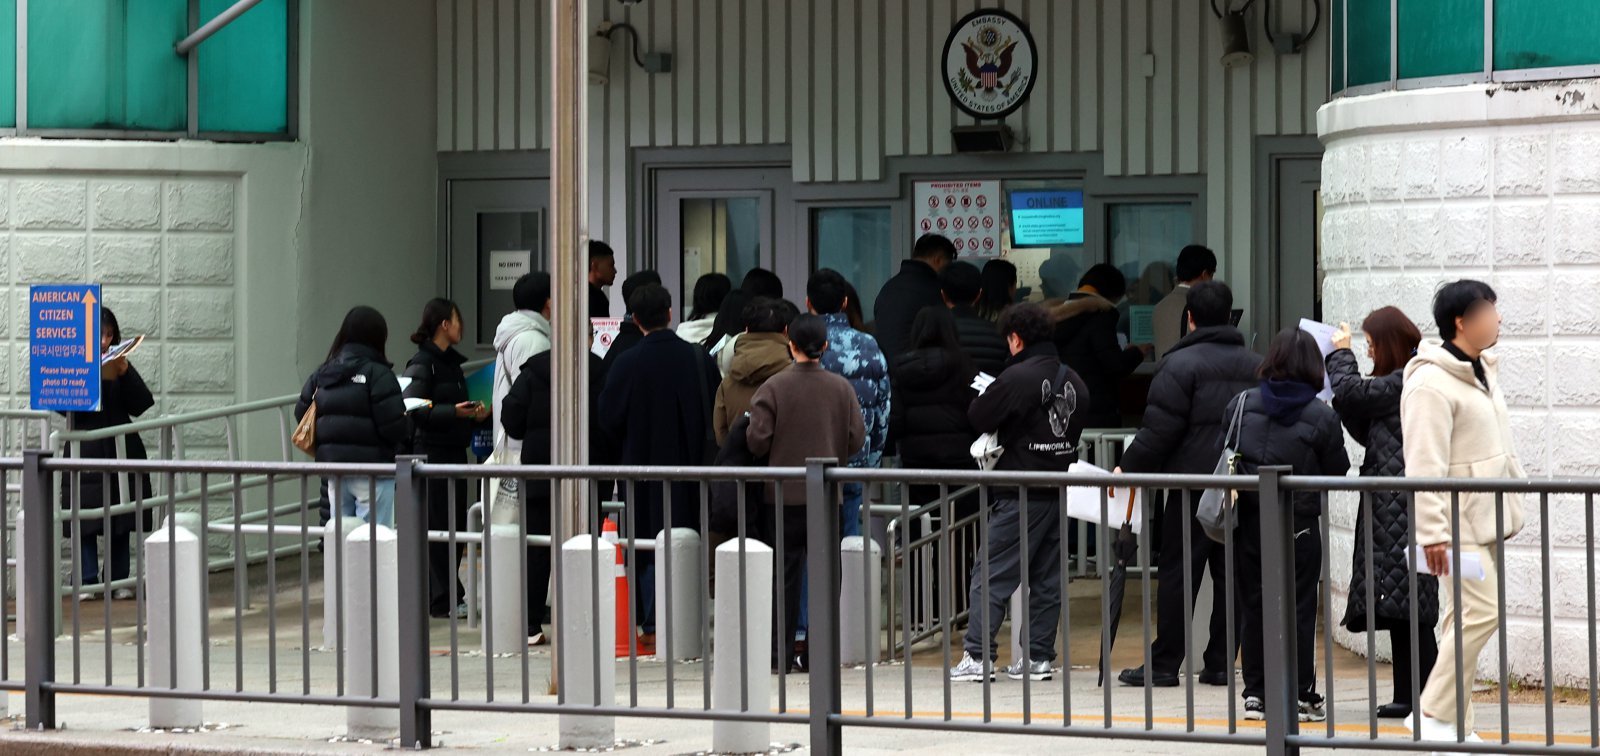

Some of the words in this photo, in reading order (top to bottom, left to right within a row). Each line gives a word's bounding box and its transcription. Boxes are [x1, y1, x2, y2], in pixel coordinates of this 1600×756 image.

[971, 17, 1006, 27] EMBASSY
[951, 77, 968, 105] UNITED
[969, 100, 995, 112] STATES
[996, 102, 1006, 111] OF
[1007, 75, 1029, 105] AMERICA
[1026, 197, 1069, 208] ONLINE
[32, 291, 80, 302] AMERICAN
[39, 309, 74, 320] CITIZEN
[36, 327, 77, 338] SERVICES
[32, 344, 85, 357] 미국시민업무과
[40, 366, 59, 374] Please
[60, 366, 74, 374] have
[76, 368, 89, 376] your
[42, 378, 60, 387] photo
[69, 378, 86, 387] ready
